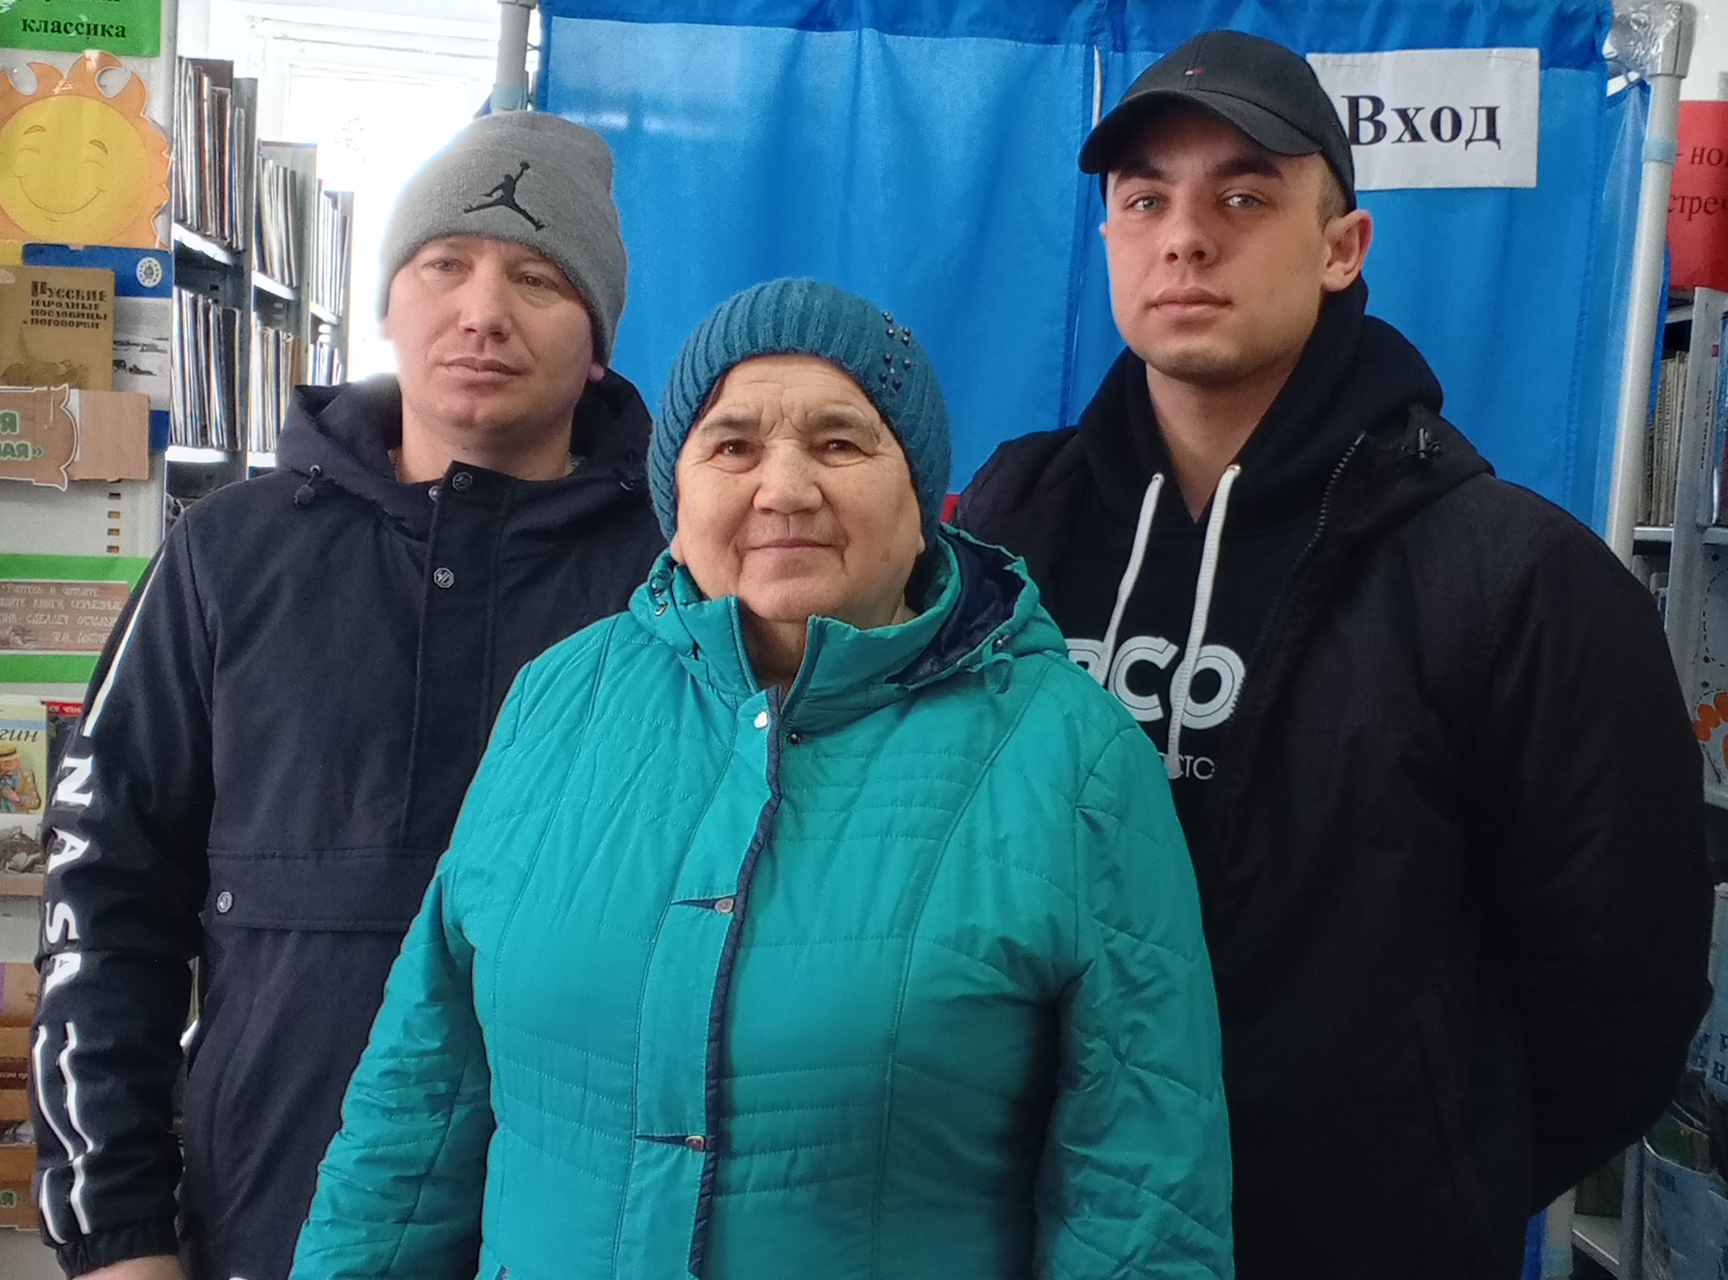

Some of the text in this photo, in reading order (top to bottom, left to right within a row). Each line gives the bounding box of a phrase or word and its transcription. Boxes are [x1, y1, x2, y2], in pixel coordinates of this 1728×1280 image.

[21, 18, 126, 38] классика
[1340, 95, 1501, 151] Вход
[1690, 146, 1728, 167] но
[47, 753, 95, 998] NASA
